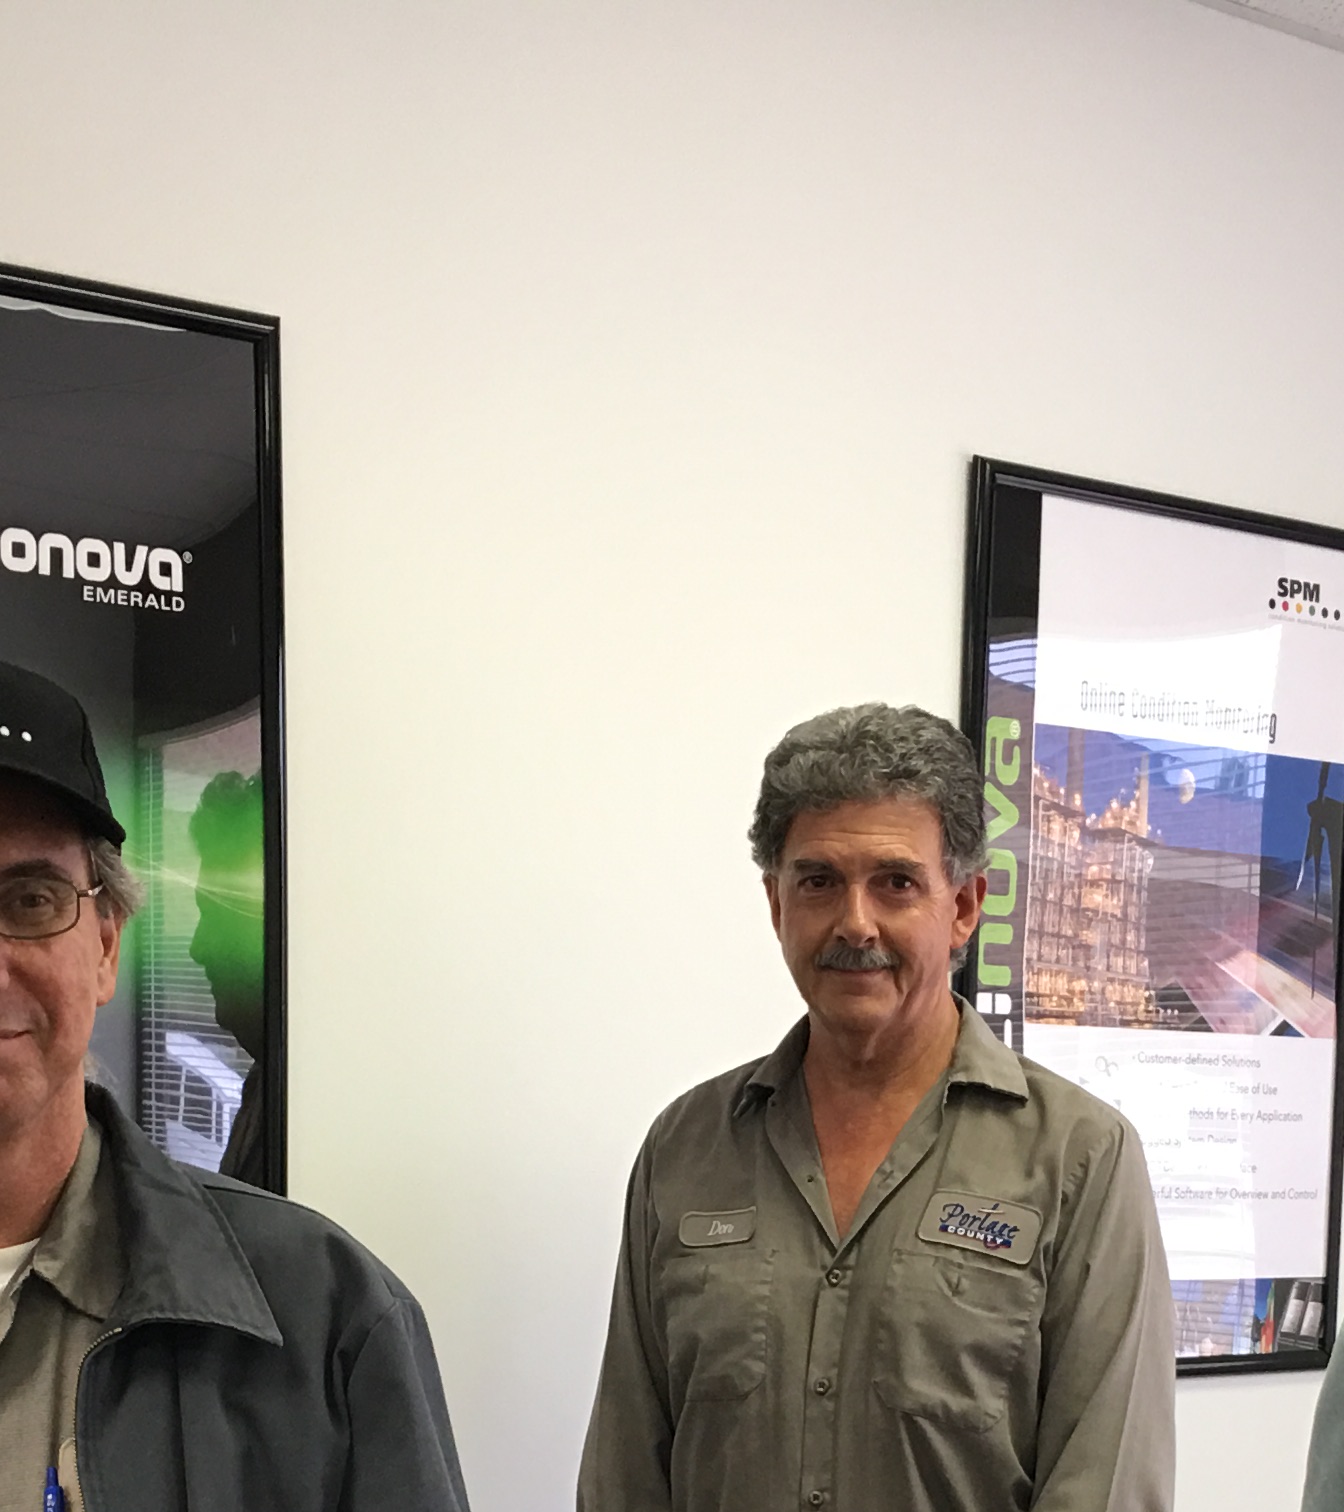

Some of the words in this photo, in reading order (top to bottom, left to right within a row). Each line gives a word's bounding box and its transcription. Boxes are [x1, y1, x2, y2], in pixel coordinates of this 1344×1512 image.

[82, 585, 185, 612] EMERALD
[1277, 577, 1320, 603] SPM
[1081, 680, 1125, 716] Online
[1138, 1052, 1219, 1066] Customer-defined
[1221, 1055, 1261, 1068] Solutions
[1262, 1083, 1278, 1096] Use
[1188, 1108, 1214, 1120] thods
[1216, 1108, 1228, 1120] for
[1256, 1110, 1303, 1124] Application
[1174, 1187, 1213, 1200] Software
[1215, 1187, 1228, 1200] for
[1230, 1187, 1268, 1200] Overview
[1271, 1188, 1286, 1200] and
[1288, 1187, 1318, 1200] Control
[947, 1225, 1004, 1245] COUNTY
